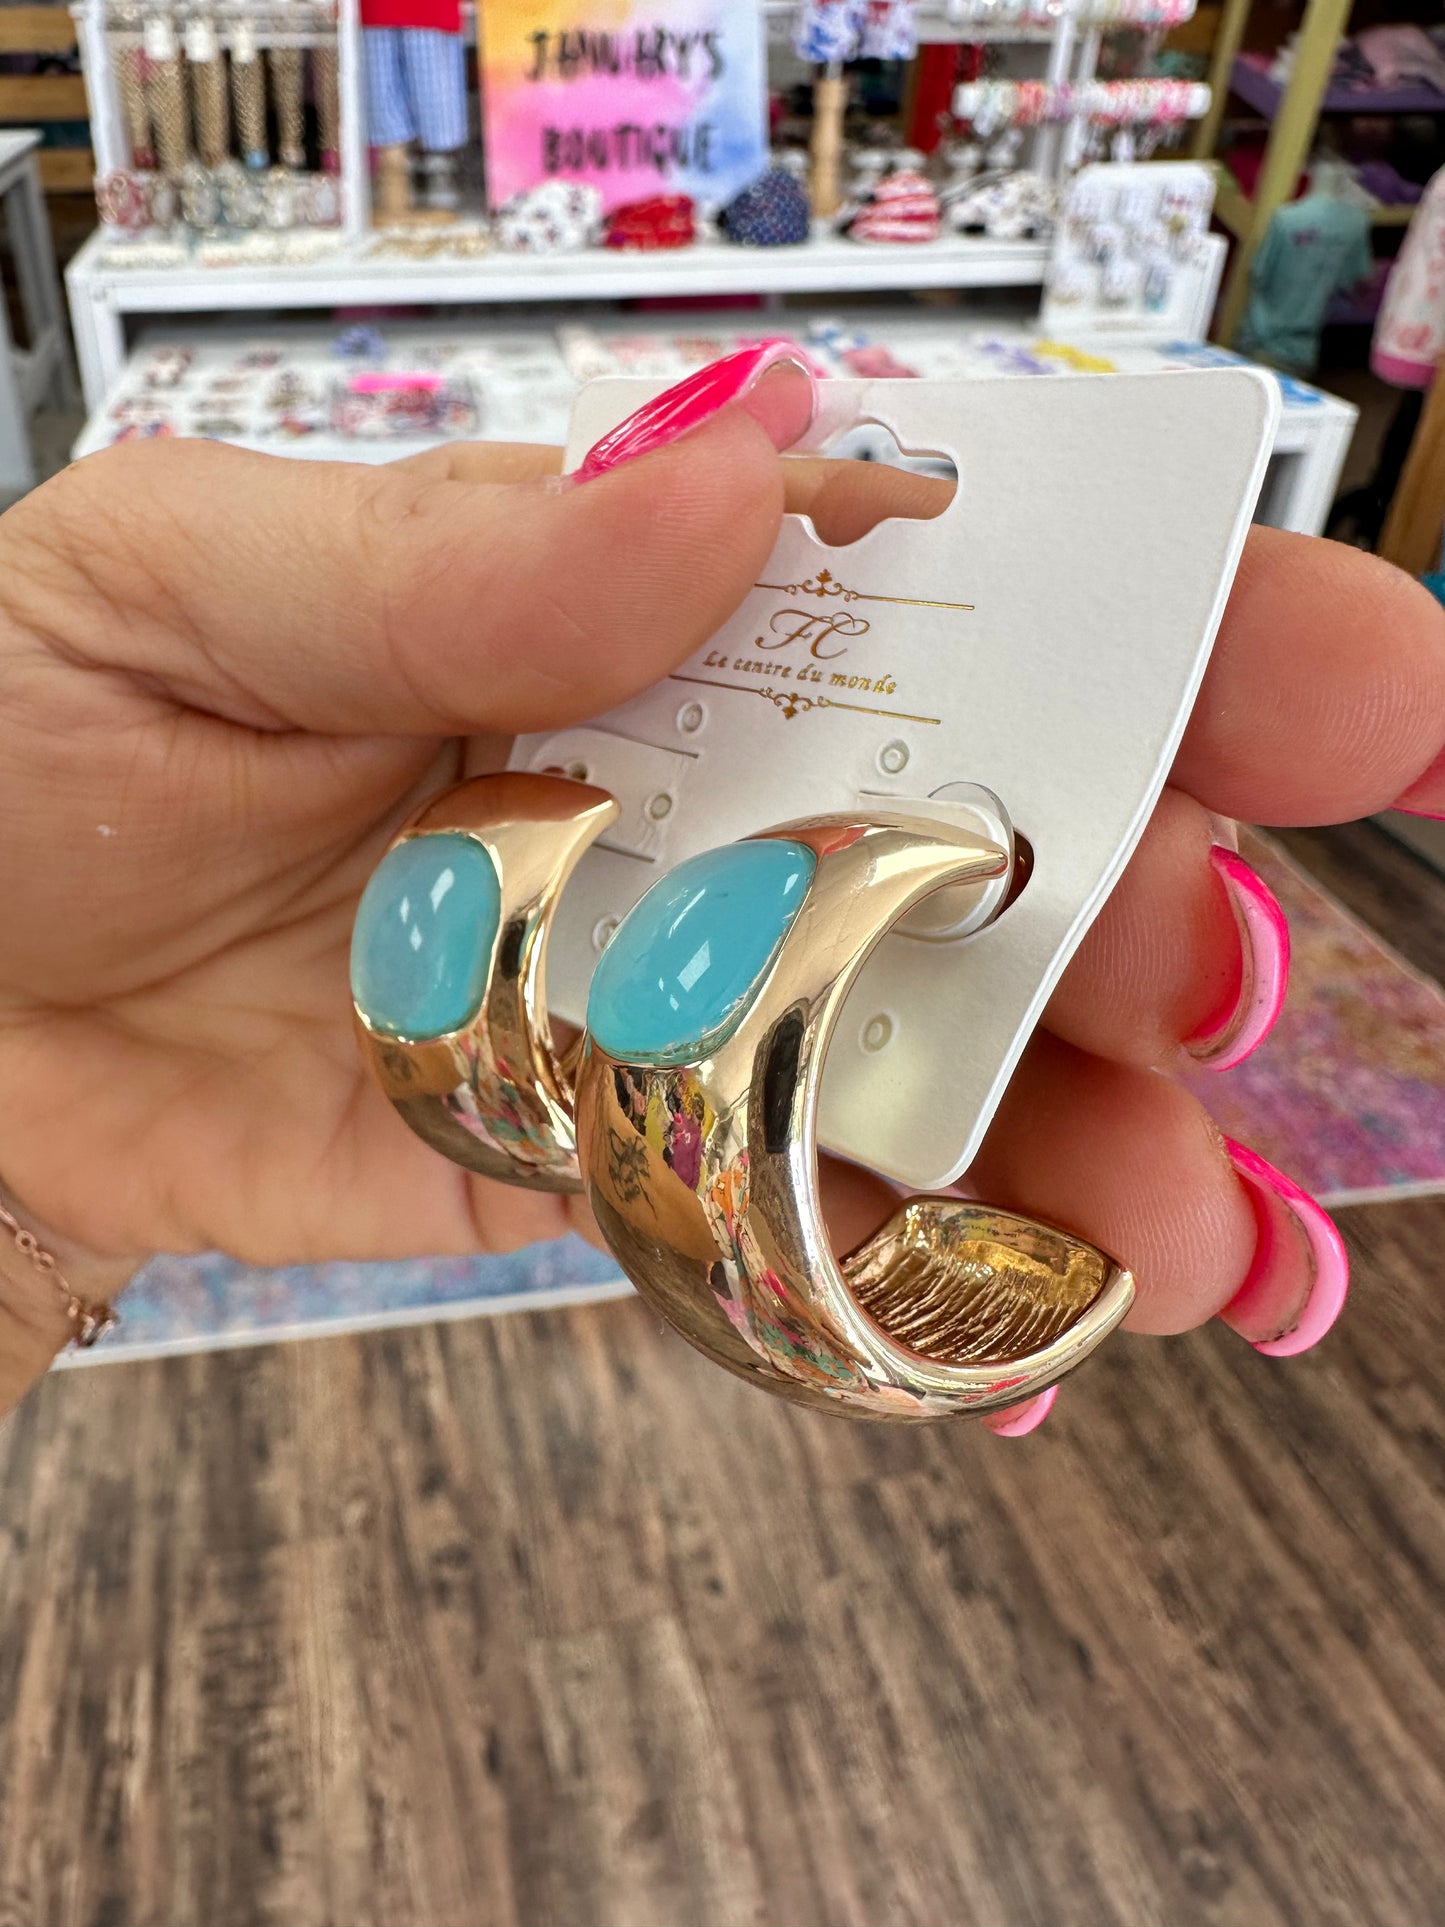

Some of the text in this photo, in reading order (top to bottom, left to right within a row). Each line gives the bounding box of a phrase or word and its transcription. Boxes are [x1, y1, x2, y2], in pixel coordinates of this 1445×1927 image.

[526, 25, 727, 81] JANUARY'S
[541, 123, 715, 178] BOUTIQUE
[755, 608, 870, 659] FC
[702, 650, 897, 695] Le centre du monde
